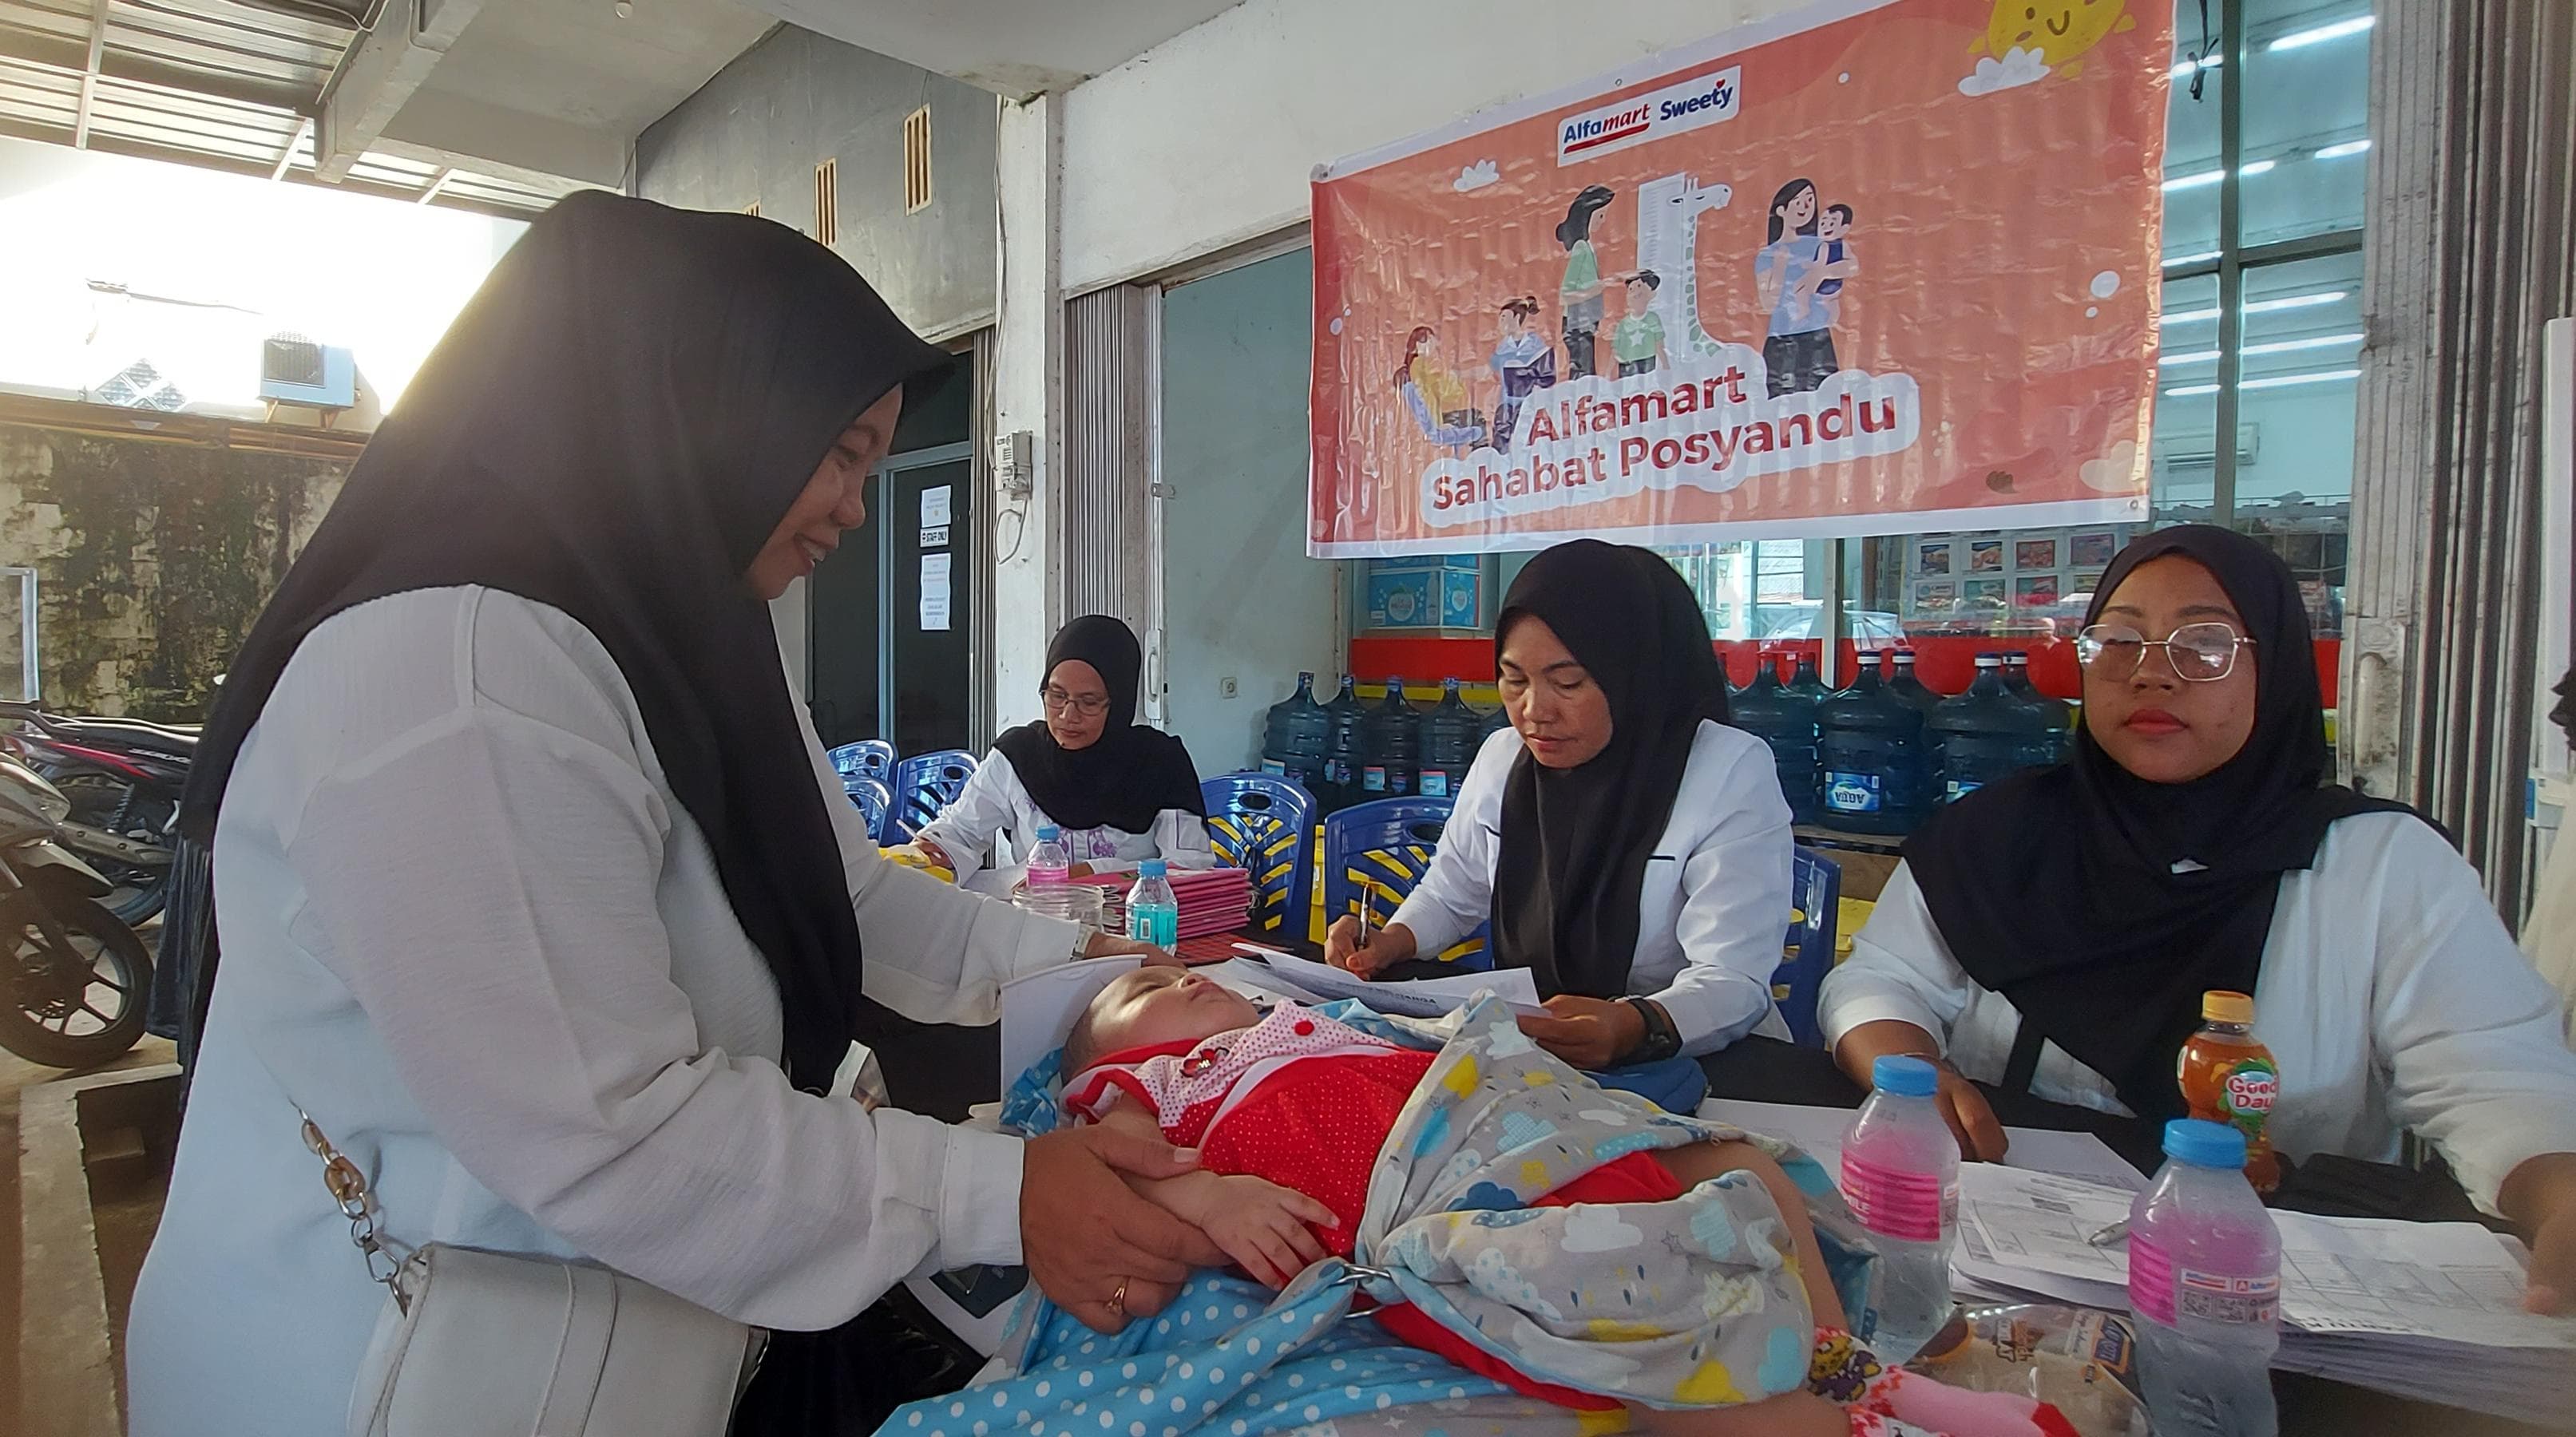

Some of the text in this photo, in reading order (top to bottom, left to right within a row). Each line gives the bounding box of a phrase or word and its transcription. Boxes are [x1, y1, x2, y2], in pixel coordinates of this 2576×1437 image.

[1563, 81, 1734, 144] Alfamart Sweety
[1526, 365, 1747, 446] Alfamart
[1431, 392, 1896, 511] Sahabat Posyandu
[1834, 790, 1865, 804] AQUA
[2235, 1094, 2273, 1112] Day
